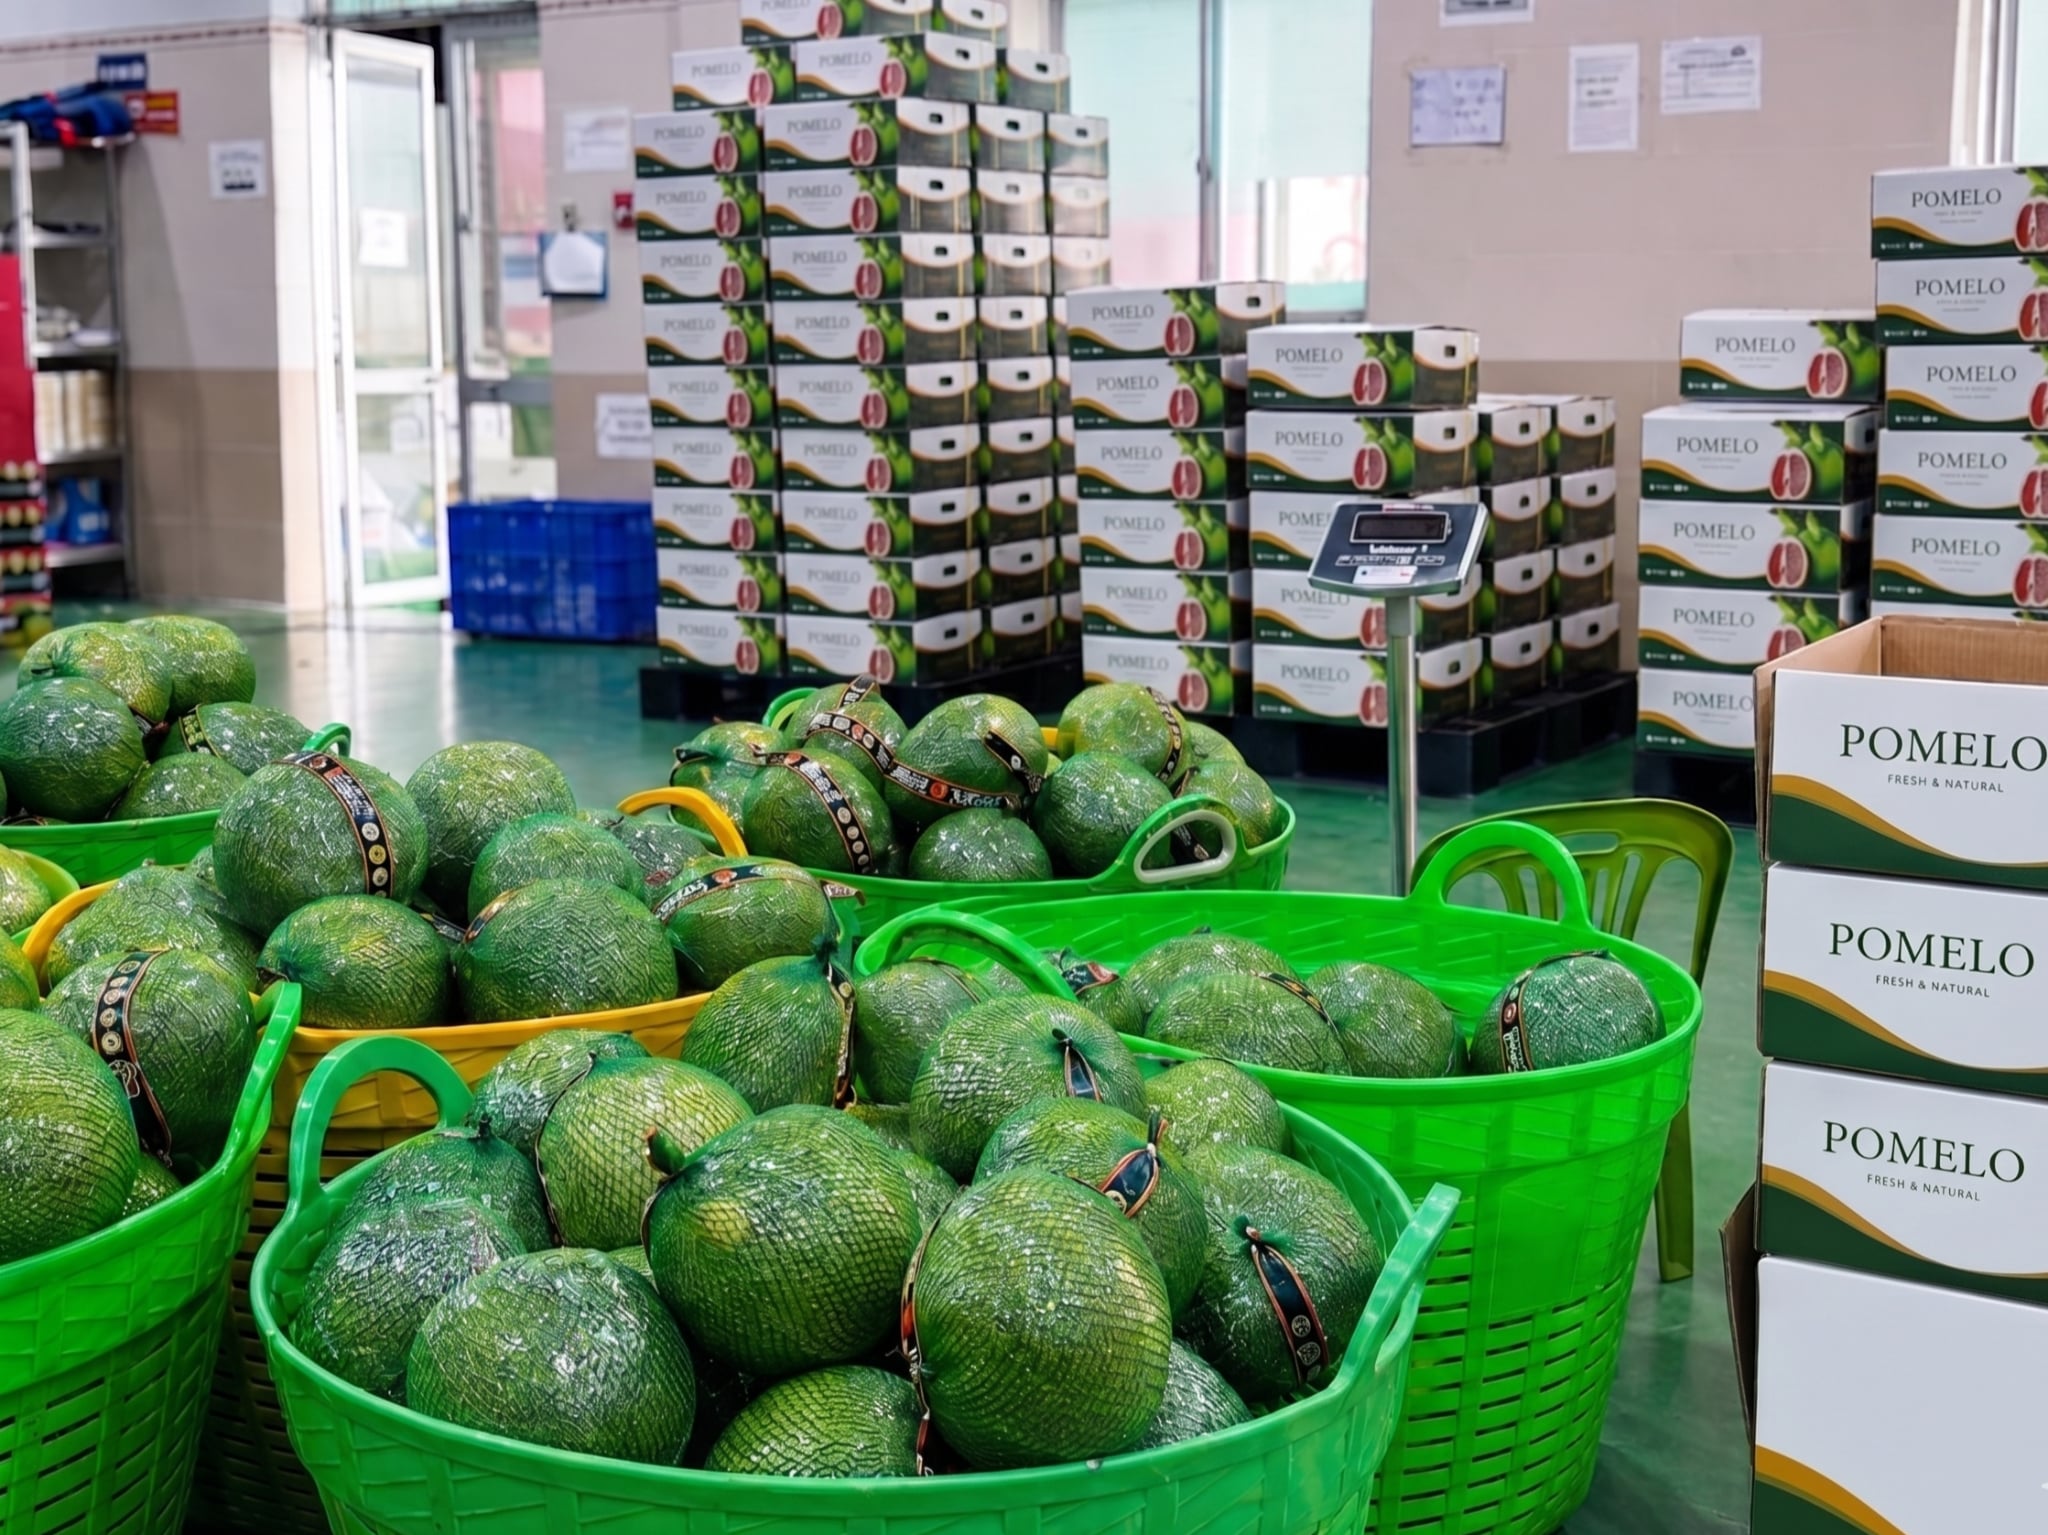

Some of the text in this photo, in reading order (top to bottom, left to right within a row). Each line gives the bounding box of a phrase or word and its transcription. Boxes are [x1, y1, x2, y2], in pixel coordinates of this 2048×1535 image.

[818, 51, 872, 68] POMELO
[691, 62, 741, 78] POMELO
[654, 126, 704, 141] POMELO
[787, 117, 841, 134] POMELO
[656, 189, 707, 205] POMELO
[788, 184, 842, 198] POMELO
[1912, 188, 2002, 208] POMELO
[660, 254, 711, 268] POMELO
[792, 250, 847, 265] POMELO
[1916, 278, 2005, 295] POMELO
[1092, 305, 1154, 320] POMELO
[664, 318, 715, 332] POMELO
[795, 314, 850, 331] POMELO
[1715, 338, 1795, 353] POMELO
[1275, 348, 1343, 363] POMELO
[1927, 366, 2016, 382] POMELO
[668, 380, 718, 394] POMELO
[799, 379, 853, 395] POMELO
[1097, 376, 1159, 392] POMELO
[1275, 431, 1343, 446] POMELO
[1677, 437, 1758, 454] POMELO
[672, 442, 722, 456] POMELO
[804, 442, 857, 457] POMELO
[1101, 446, 1162, 461] POMELO
[1918, 452, 2007, 469] POMELO
[672, 502, 722, 517] POMELO
[804, 506, 858, 522] POMELO
[1104, 516, 1164, 531] POMELO
[1279, 511, 1331, 527] POME
[1674, 522, 1755, 540] POMELO
[1912, 538, 2000, 556] POMELO
[678, 563, 729, 578] POMELO
[808, 569, 861, 585] POMELO
[1106, 585, 1167, 600] POMELO
[1674, 609, 1755, 627] POMELO
[678, 624, 728, 639] POMELO
[808, 631, 861, 648] POMELO
[1108, 654, 1169, 670] POMELO
[1281, 664, 1350, 682] POMELO
[1673, 691, 1753, 712] POMELO
[1840, 724, 2048, 772] POMELO
[1888, 774, 2003, 792] FRESH & NATURAL
[1829, 923, 2034, 977] POMELO
[1876, 975, 1990, 997] FRESH & NATURAL
[1823, 1120, 2024, 1183] POMELO
[1867, 1174, 1981, 1201] FRESH & NATURAL
